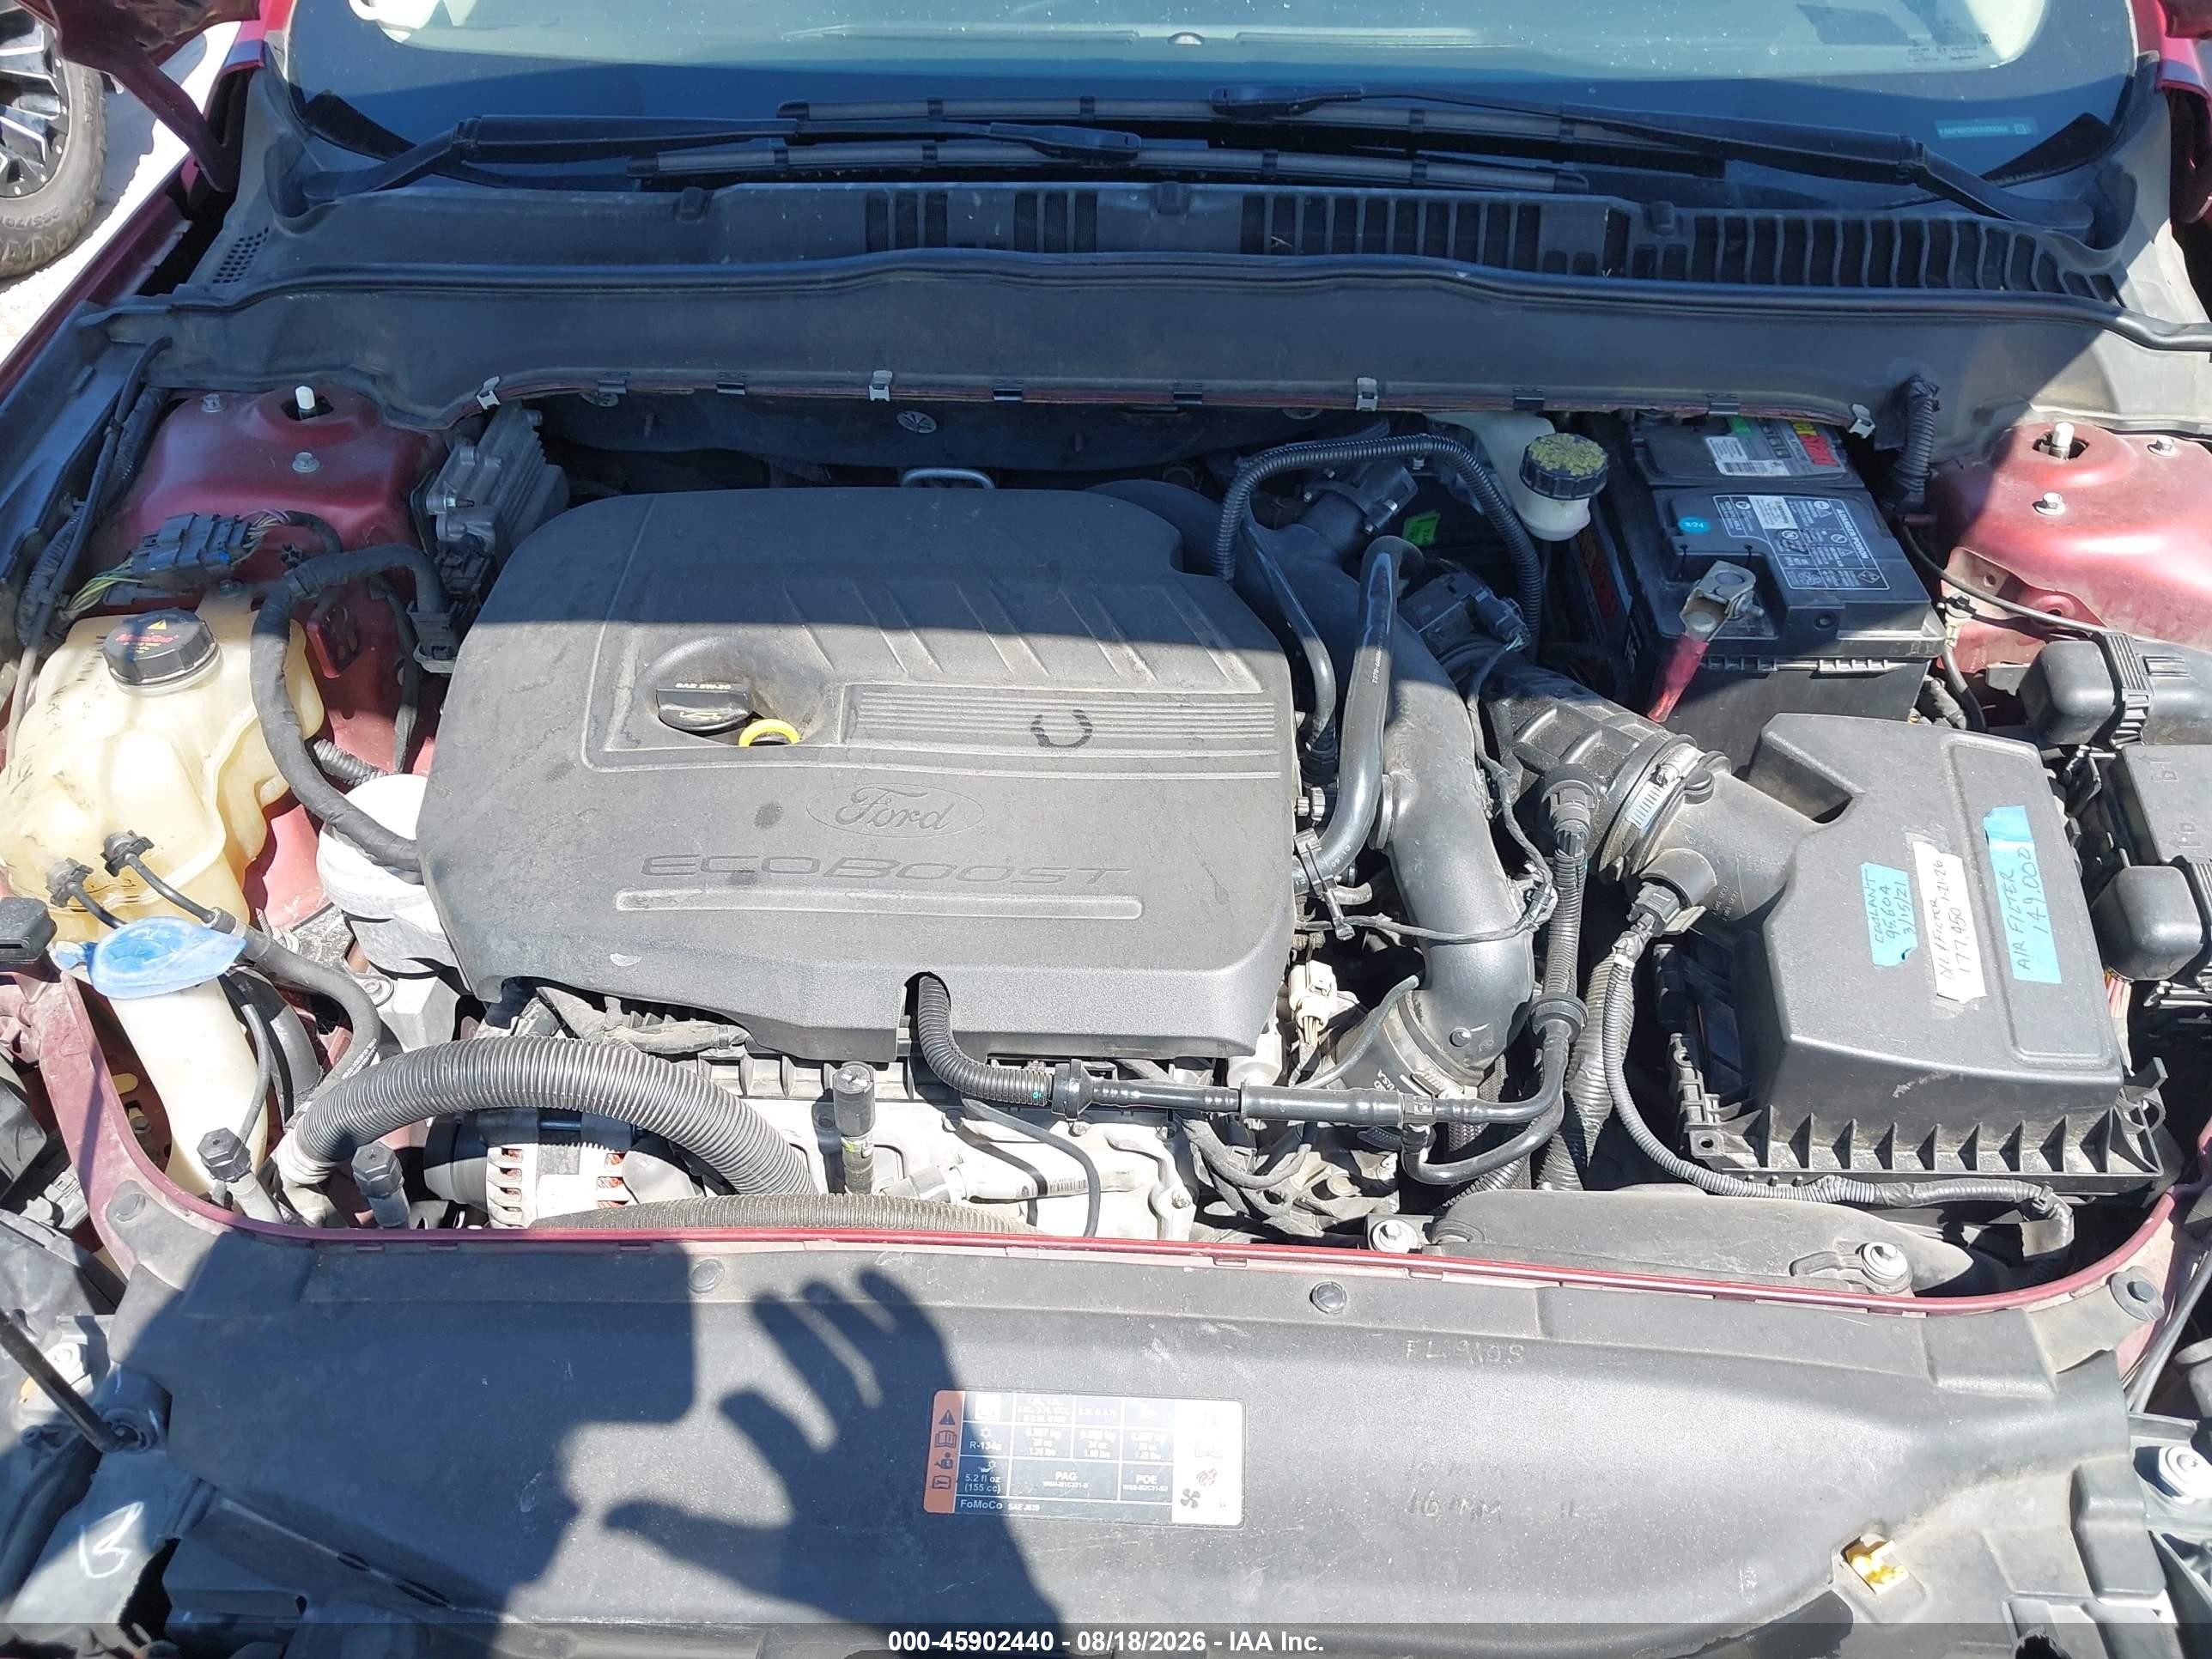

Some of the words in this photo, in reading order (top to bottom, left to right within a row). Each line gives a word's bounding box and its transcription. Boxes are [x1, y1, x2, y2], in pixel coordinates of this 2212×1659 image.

[836, 787, 955, 830] Ford
[2000, 868, 2023, 933] FILTER
[2011, 940, 2031, 970] AIR
[964, 1474, 979, 1482] 5.2
[1054, 1471, 1078, 1481] PAG
[1135, 1474, 1158, 1485] POE
[964, 1483, 985, 1492] (155
[987, 1484, 1001, 1494] cc)
[960, 1498, 1003, 1510] FoMoCo
[1007, 1503, 1023, 1511] SAE
